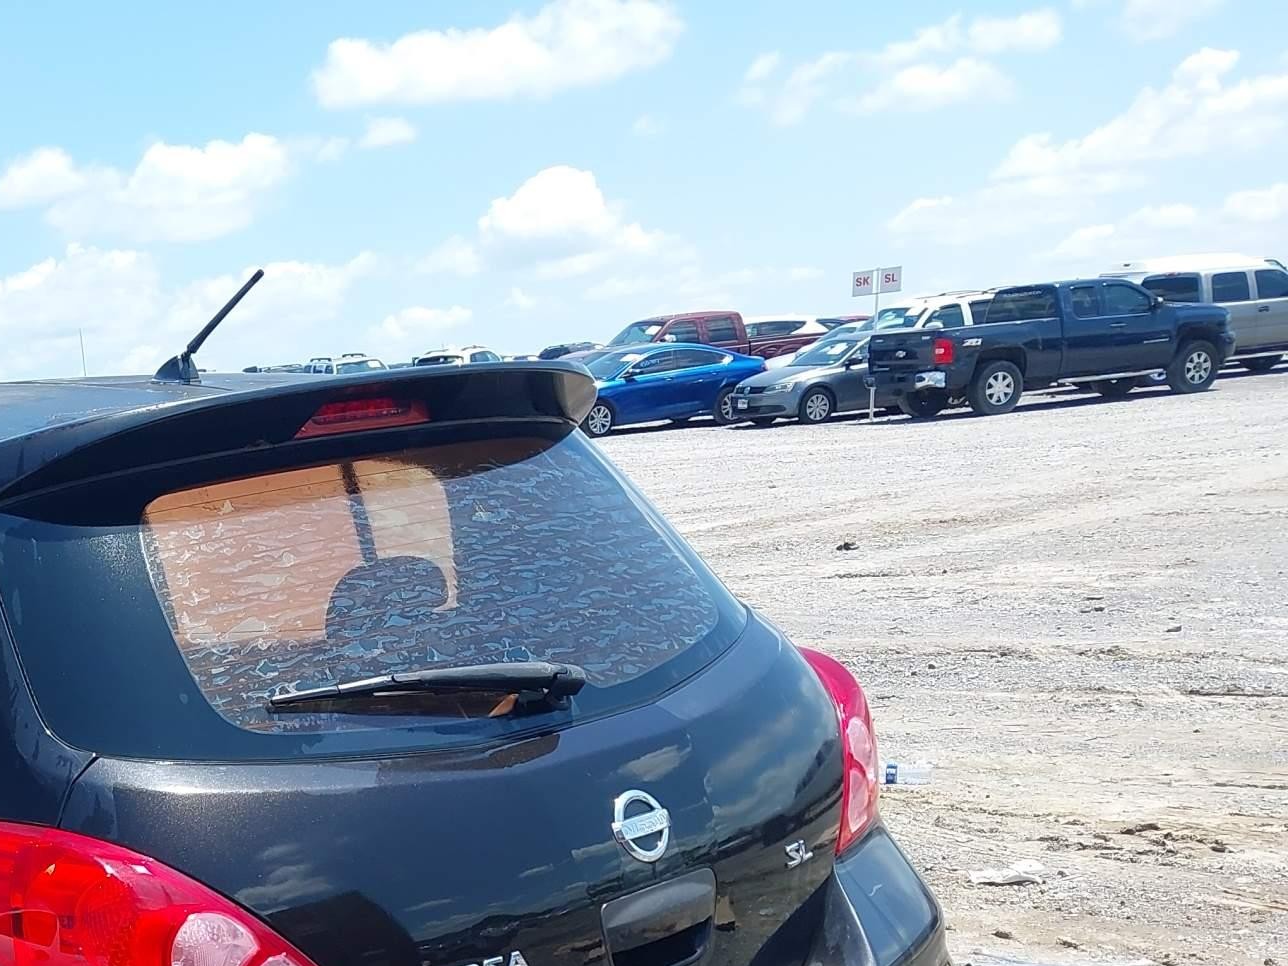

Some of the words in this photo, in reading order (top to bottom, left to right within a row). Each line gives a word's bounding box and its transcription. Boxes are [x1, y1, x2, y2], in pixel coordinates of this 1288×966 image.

[855, 276, 870, 287] SK
[884, 273, 897, 283] SL
[785, 839, 814, 868] SL
